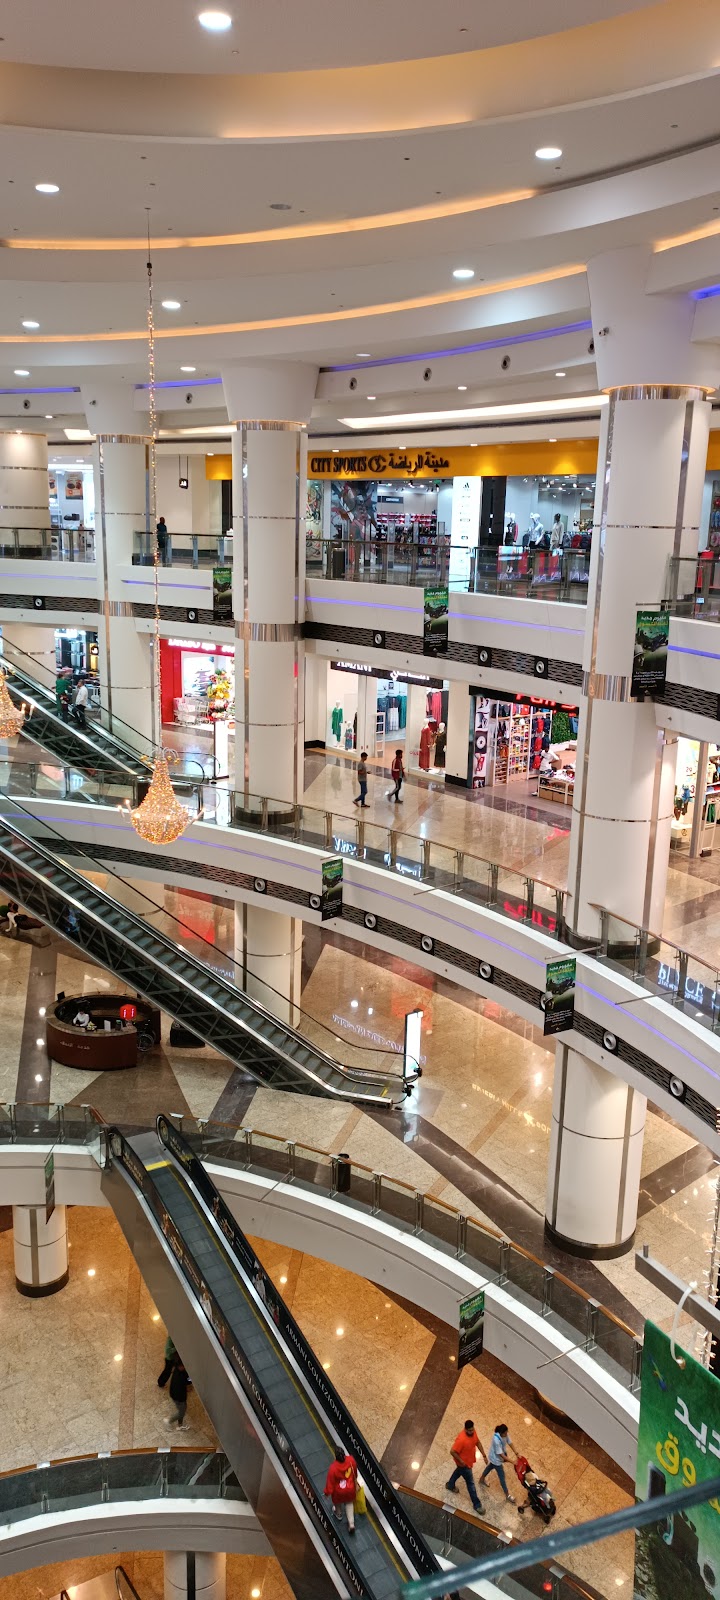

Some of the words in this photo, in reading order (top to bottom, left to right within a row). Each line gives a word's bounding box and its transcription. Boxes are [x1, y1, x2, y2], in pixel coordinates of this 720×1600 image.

[311, 458, 332, 473] CITY
[333, 456, 367, 473] SPORTS
[389, 453, 423, 474] الرياضة
[424, 452, 450, 473] مدينة
[285, 1323, 309, 1361] ARMANI
[307, 1360, 343, 1423] COLLEZIONI
[345, 1426, 389, 1499] FAÇONNABLE
[391, 1506, 426, 1564] SANTONI
[230, 1344, 253, 1388] ARMANI
[288, 1453, 329, 1532] FAÇONNABLE
[331, 1537, 365, 1597] SANTONI
